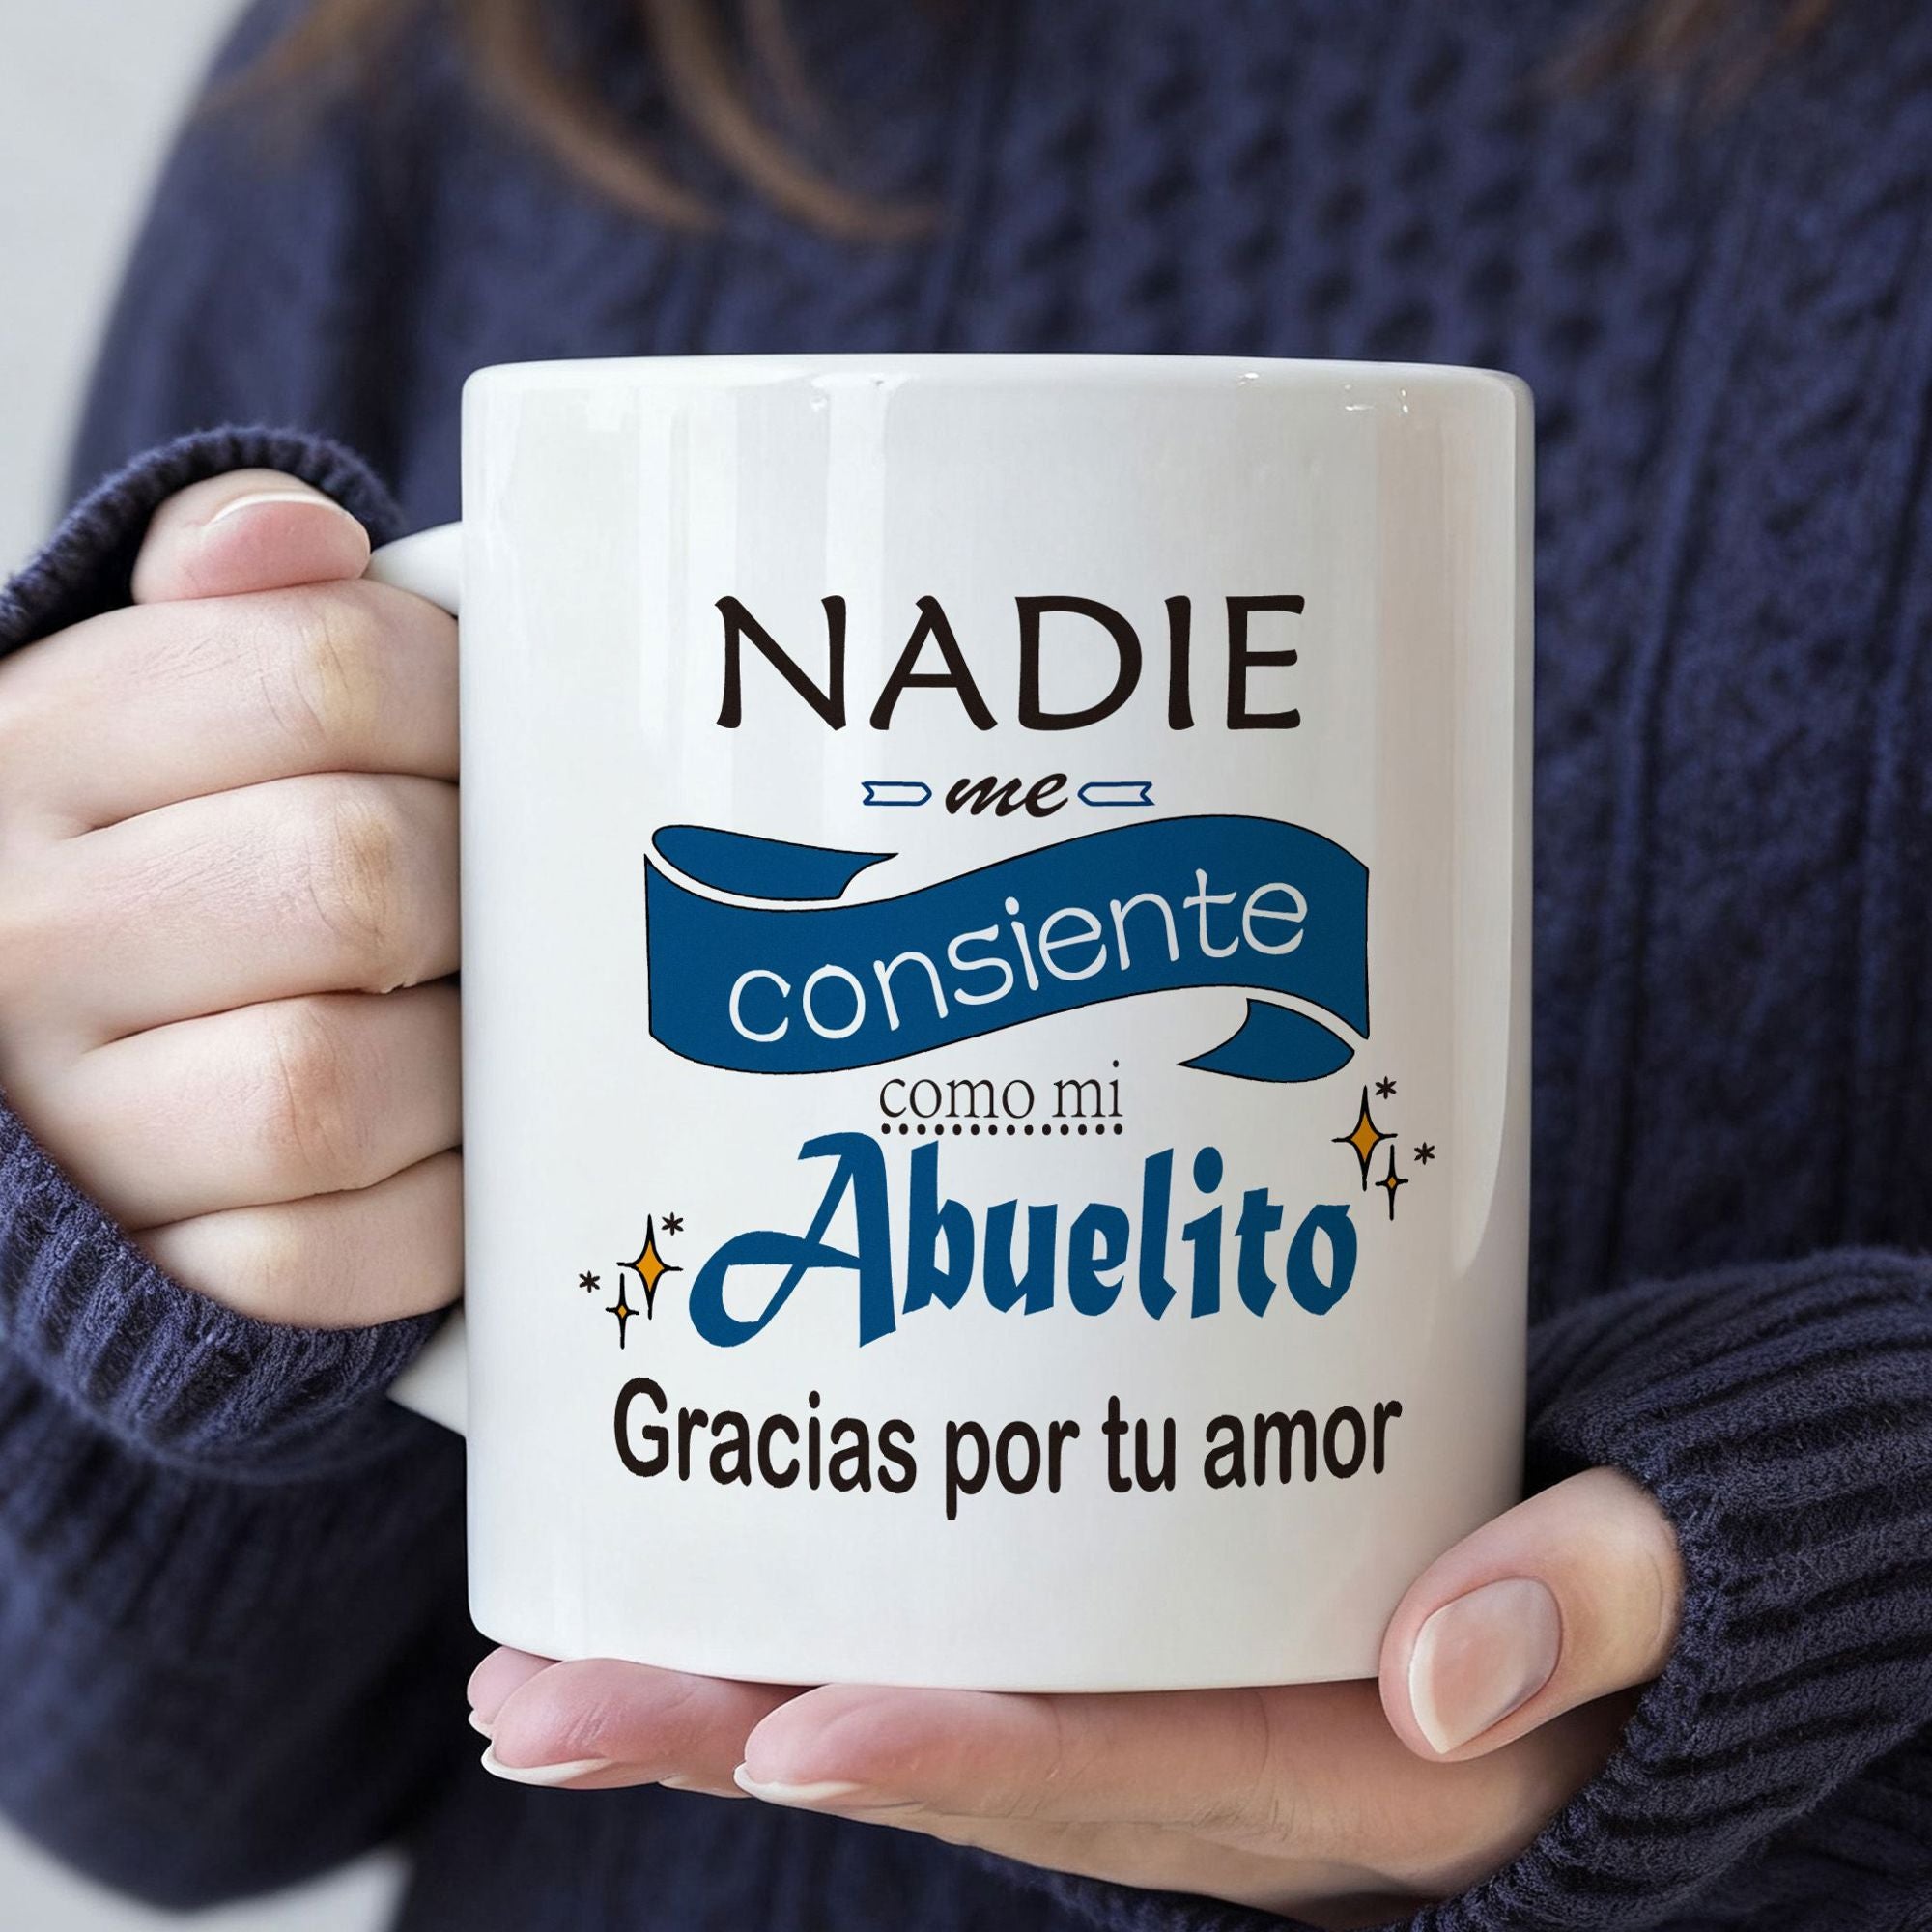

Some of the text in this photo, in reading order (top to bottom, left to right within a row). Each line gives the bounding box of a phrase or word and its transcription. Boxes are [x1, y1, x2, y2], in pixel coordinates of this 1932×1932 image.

[714, 594, 1306, 731] NADIE
[945, 773, 1068, 818] me
[728, 867, 1309, 1043] consiente
[879, 1060, 1123, 1119] como mi
[688, 1130, 1360, 1348] Abuelito
[613, 1377, 1404, 1520] Gracias por tu amor
